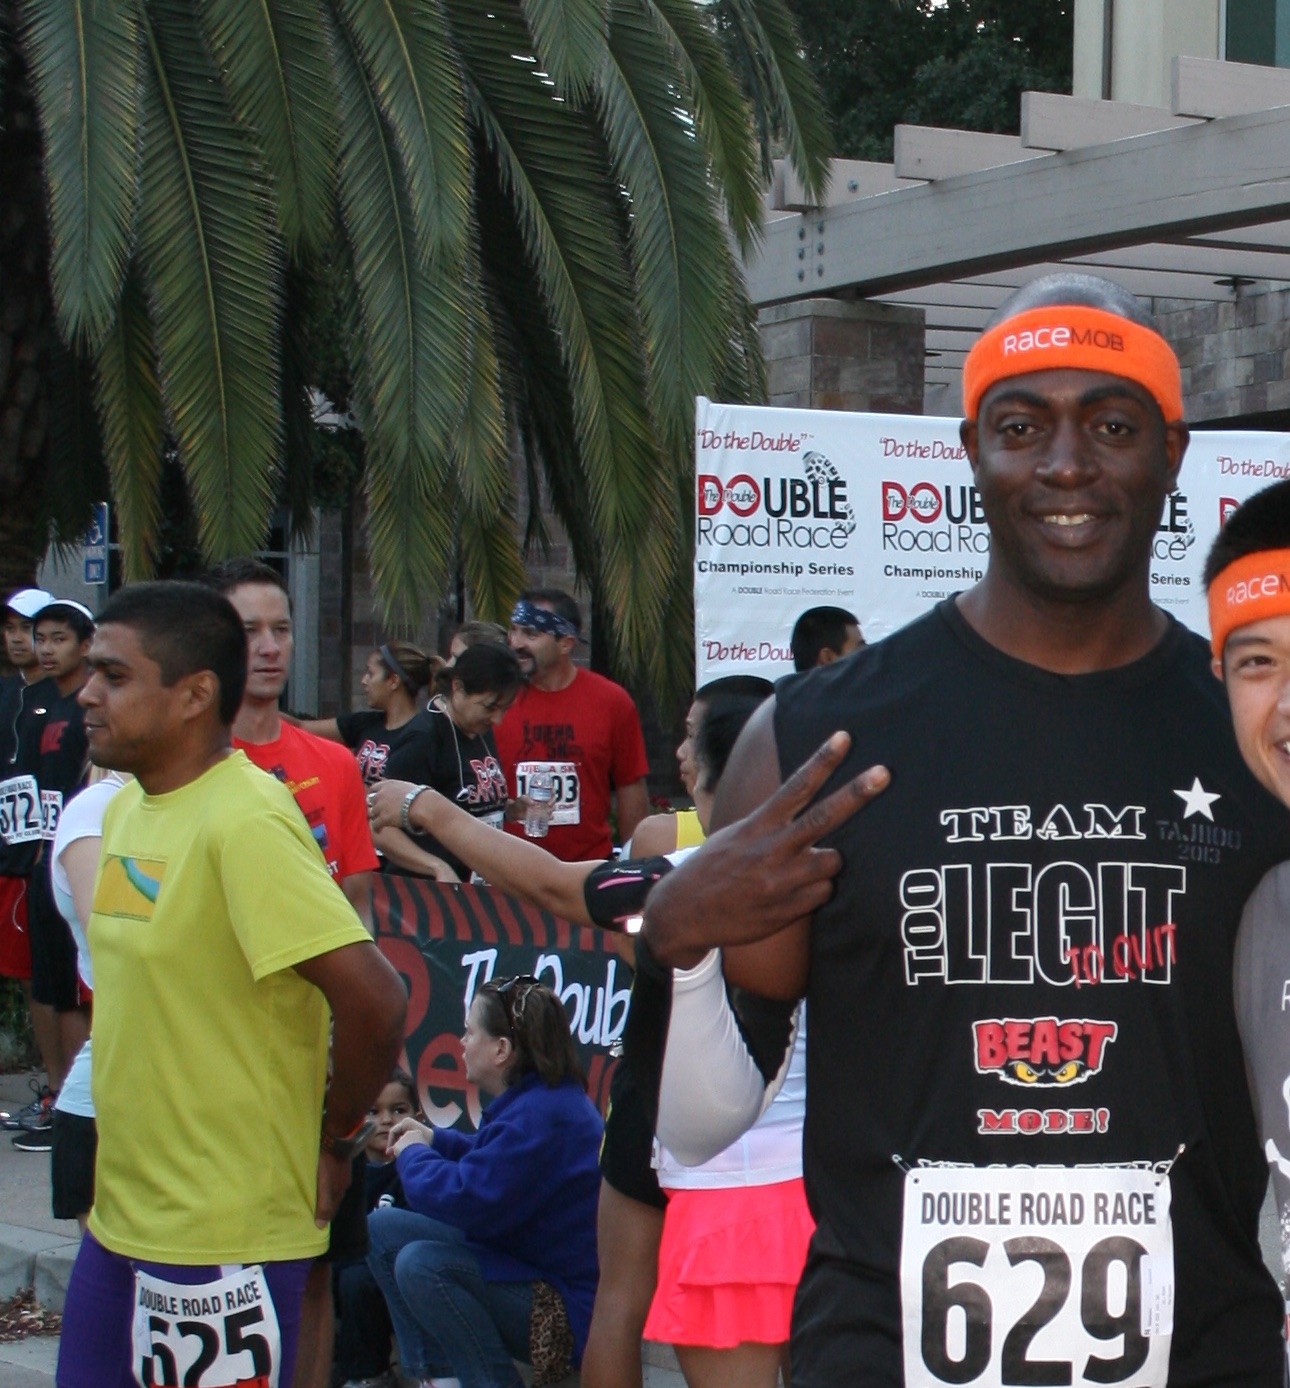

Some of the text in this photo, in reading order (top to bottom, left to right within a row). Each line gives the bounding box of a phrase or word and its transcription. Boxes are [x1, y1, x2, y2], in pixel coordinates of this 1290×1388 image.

[1003, 326, 1124, 356] RaceMOB
[723, 431, 750, 450] the
[906, 440, 930, 459] the
[932, 441, 969, 461] Doub
[1240, 458, 1263, 477] the
[697, 473, 848, 520] DOUBLE
[881, 480, 988, 525] DOUB
[697, 516, 849, 549] Road Race
[882, 522, 990, 554] Road Ra
[1151, 539, 1187, 561] ce
[697, 560, 855, 577] Championship Series
[884, 564, 983, 581] Championship
[1151, 572, 1191, 586] Series
[730, 642, 758, 661] the
[759, 643, 795, 662] Dou
[518, 774, 578, 803] 193
[940, 803, 1147, 843] TEAM
[1178, 844, 1221, 865] 2013
[899, 860, 1187, 987] TOO LEGIT
[1064, 922, 1178, 990] TO QUIT
[533, 953, 632, 1047] Doub
[973, 1016, 1118, 1074] BEAST
[977, 1108, 1110, 1135] MODE!
[921, 1191, 1157, 1226] DOUBLE ROAD RACE
[139, 1280, 262, 1318] DOUBLE ROAD RACE
[920, 1235, 1151, 1386] 629
